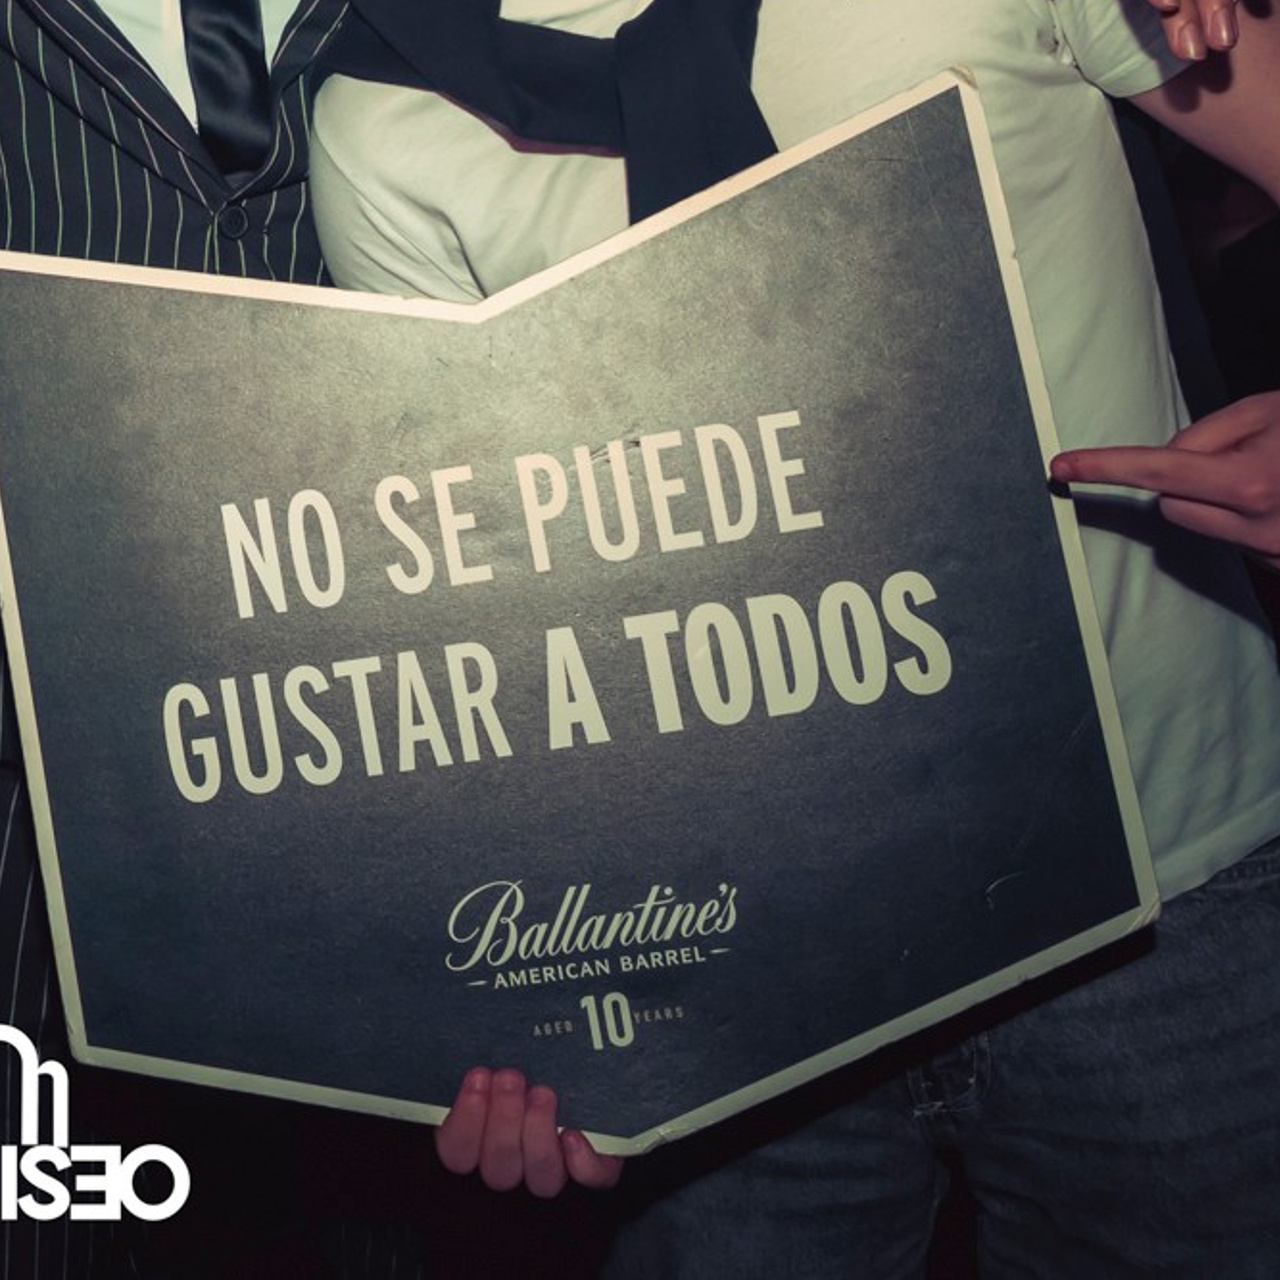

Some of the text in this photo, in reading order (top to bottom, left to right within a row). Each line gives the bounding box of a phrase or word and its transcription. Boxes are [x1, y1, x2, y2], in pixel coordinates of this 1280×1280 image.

[220, 409, 824, 619] NO SE PUEDE
[162, 570, 953, 804] GUSTAR A TODOS
[444, 879, 738, 972] Ballantine's
[493, 945, 708, 990] AMERICAN BARREL
[532, 991, 686, 1051] AGED 10 YEARS
